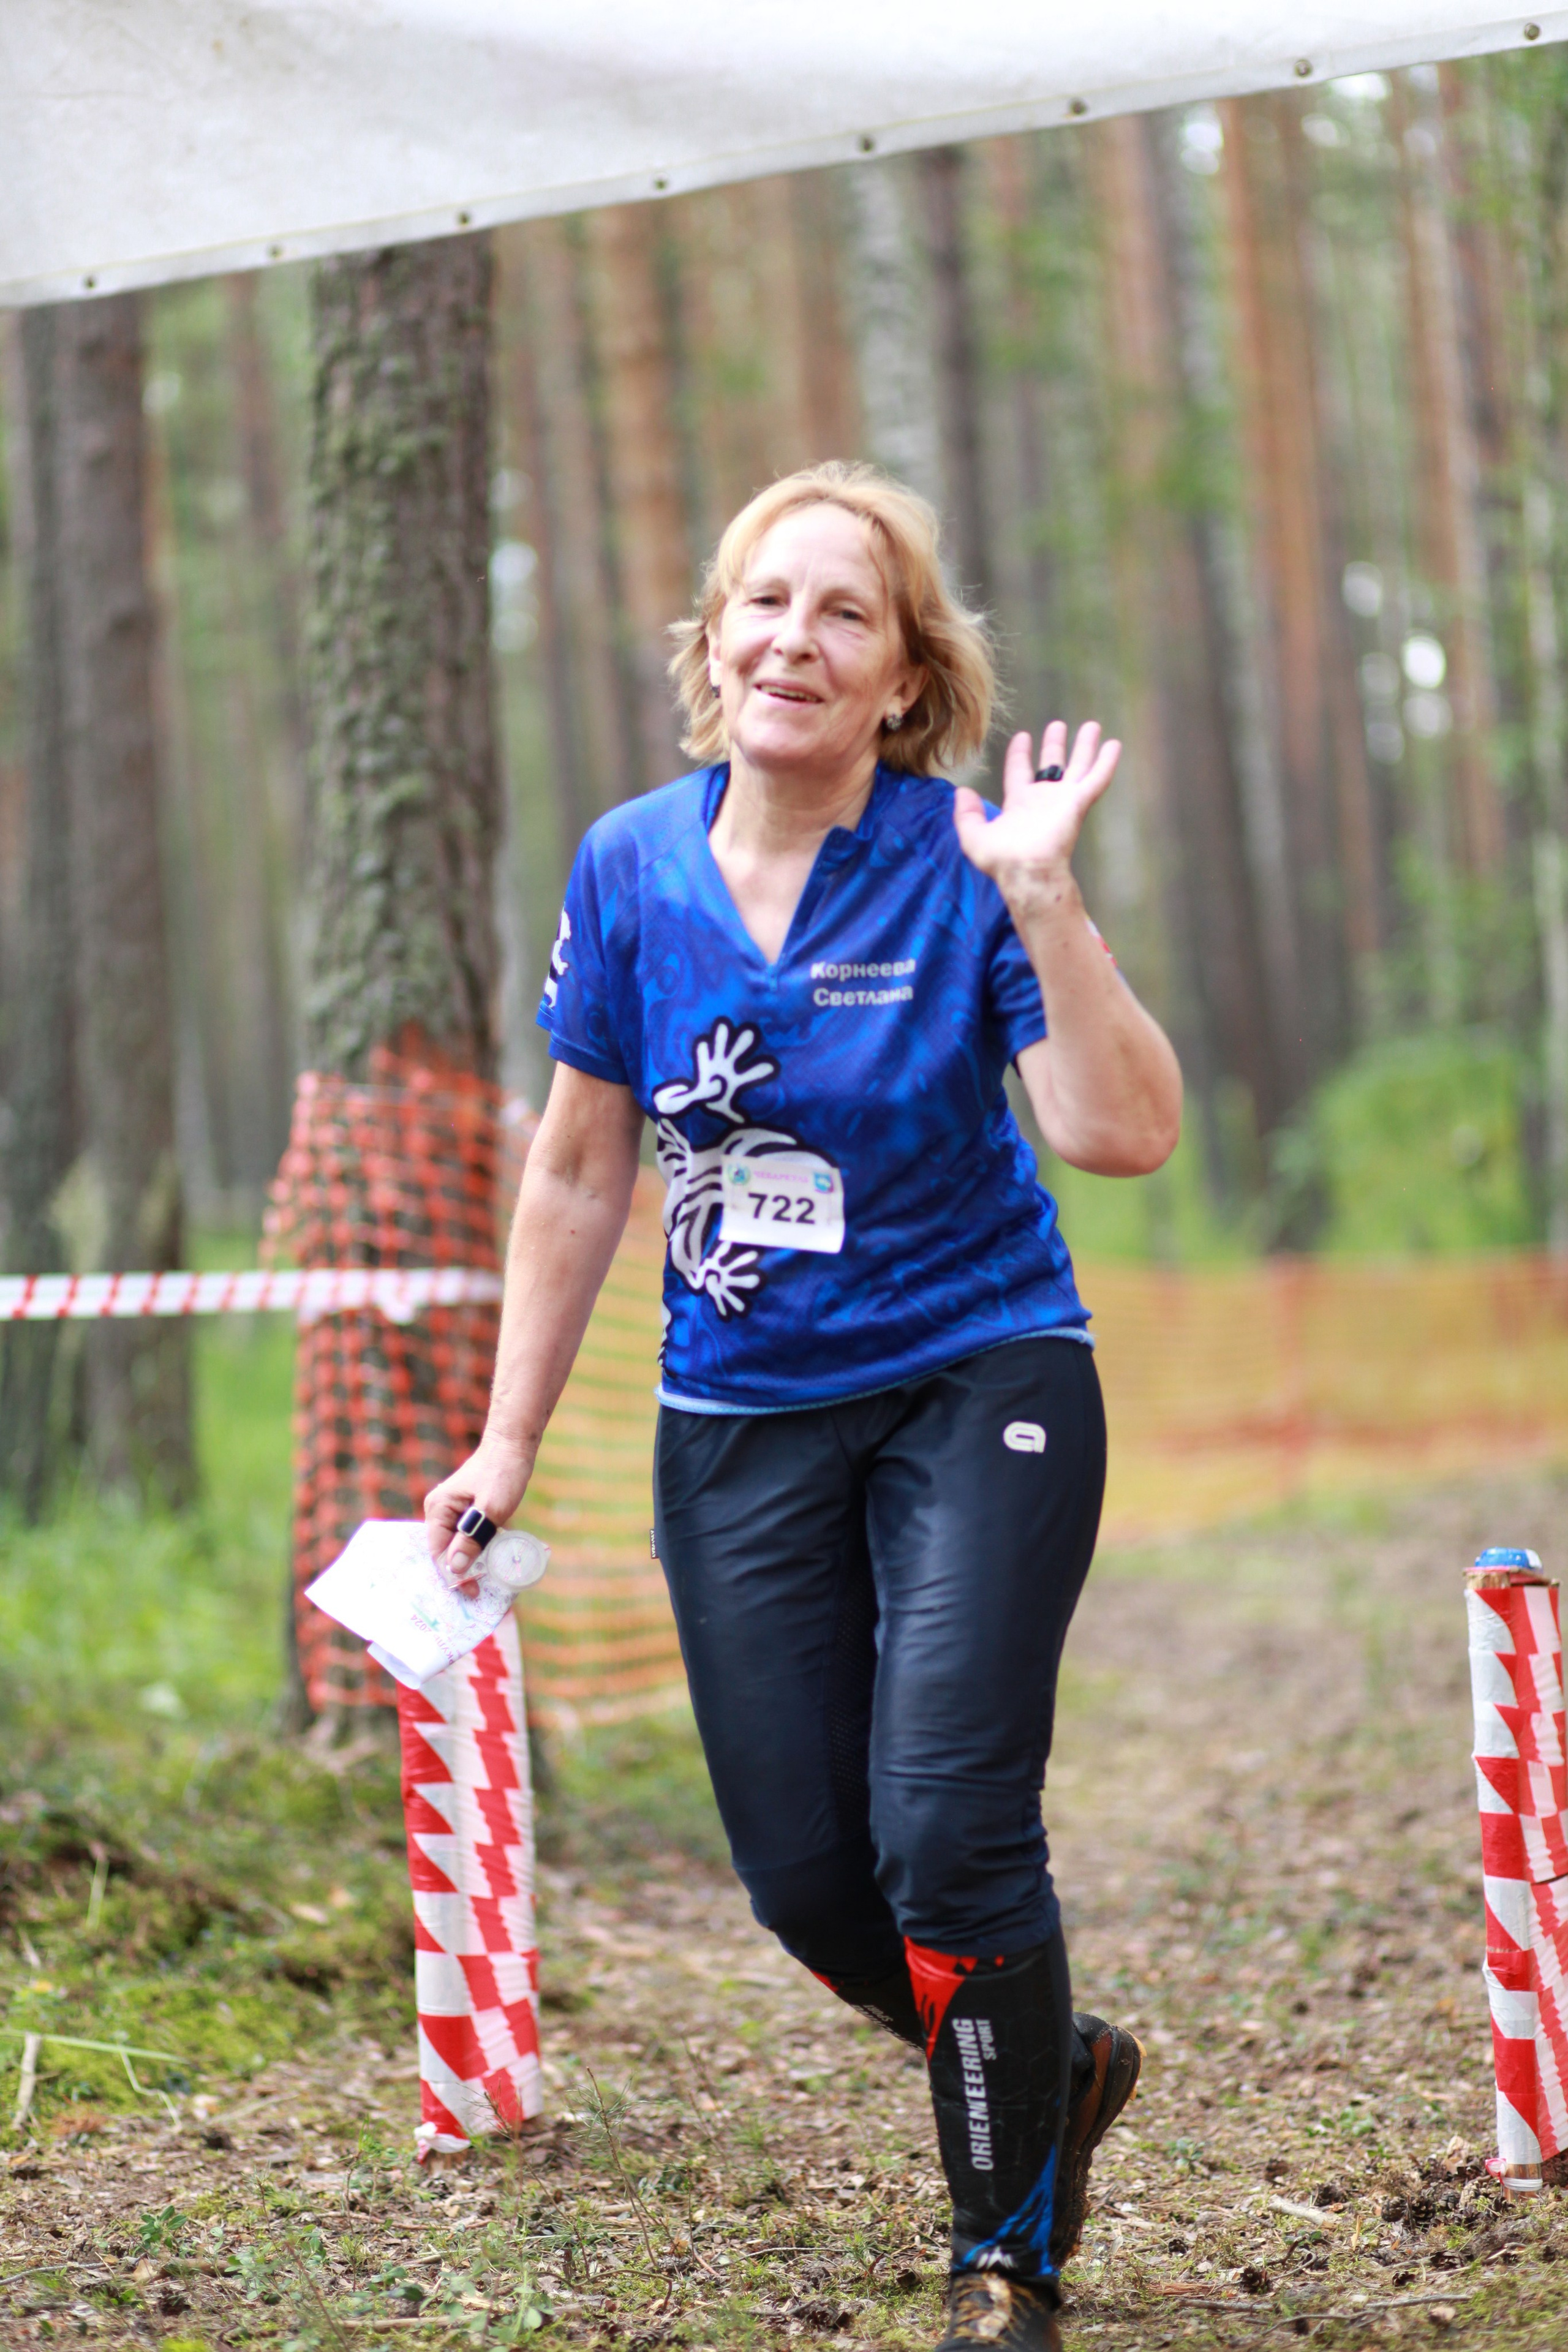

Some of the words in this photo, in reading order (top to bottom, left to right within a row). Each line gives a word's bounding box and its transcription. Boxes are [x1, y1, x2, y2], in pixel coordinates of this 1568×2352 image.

[810, 959, 916, 982] Корнеева
[813, 986, 913, 1006] Светлана
[747, 1193, 815, 1224] 722
[410, 1614, 432, 1633] 2024
[976, 2018, 997, 2060] SPORT
